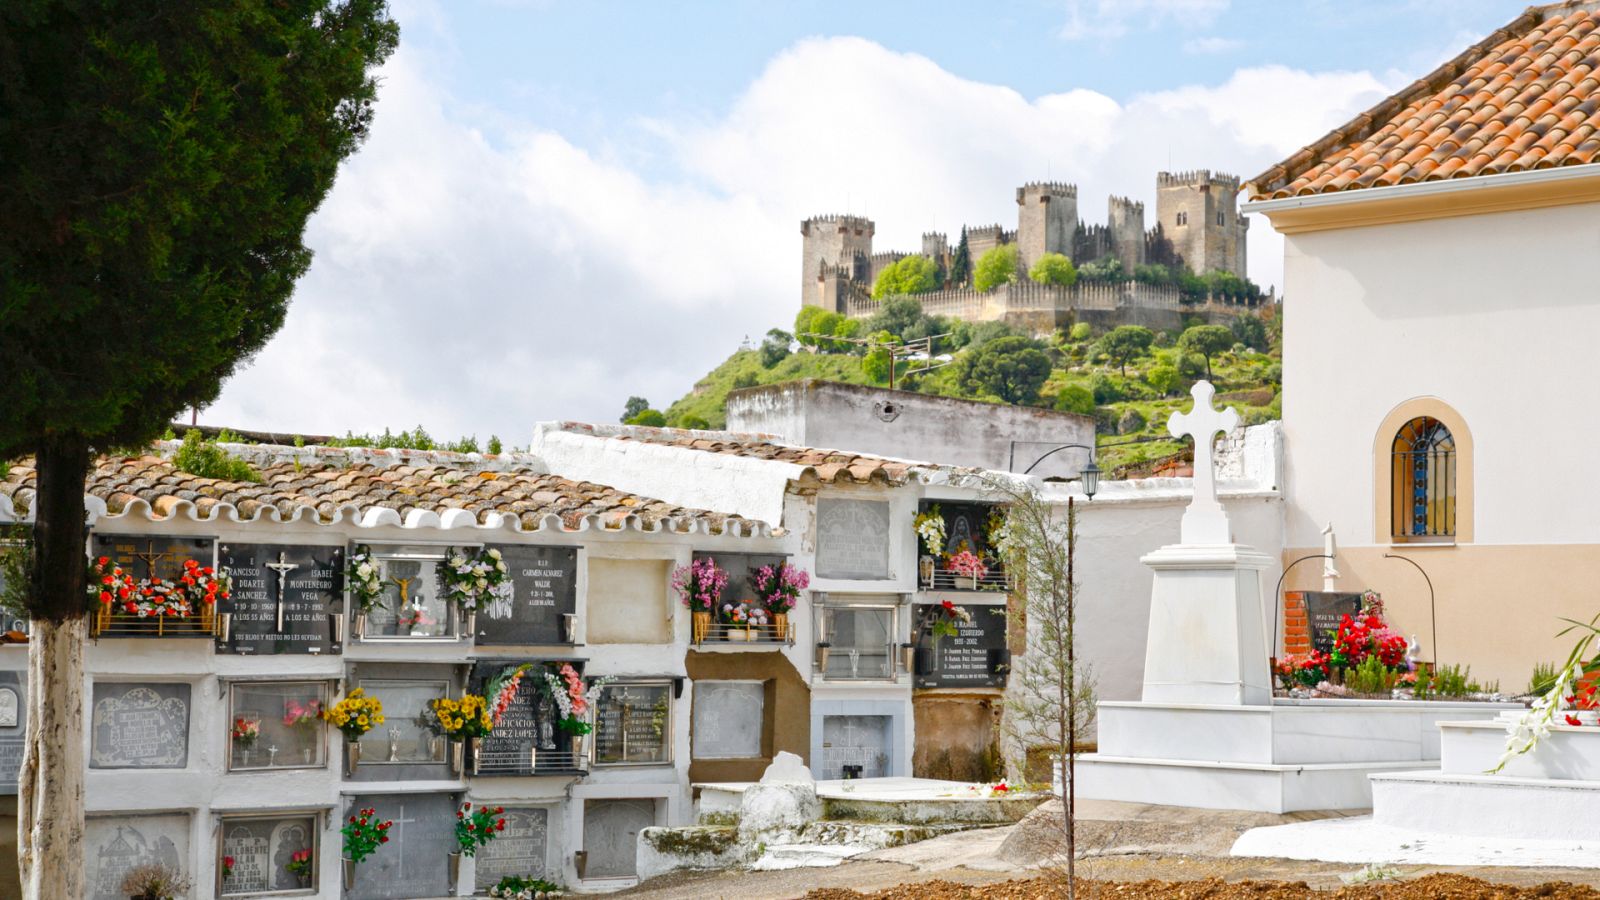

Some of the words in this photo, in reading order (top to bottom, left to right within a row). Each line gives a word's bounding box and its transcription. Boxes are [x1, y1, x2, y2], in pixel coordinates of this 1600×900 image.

[225, 568, 260, 577] FRANCISCO
[311, 569, 333, 578] ISABEL
[239, 579, 265, 588] DUARTE
[289, 580, 332, 589] MONTENEGRO
[237, 591, 268, 600] SANCHEZ
[301, 592, 319, 600] VEGA
[494, 719, 536, 728] RIFICACION
[514, 729, 538, 738] LOPEZ
[235, 846, 268, 855] LORENTE
